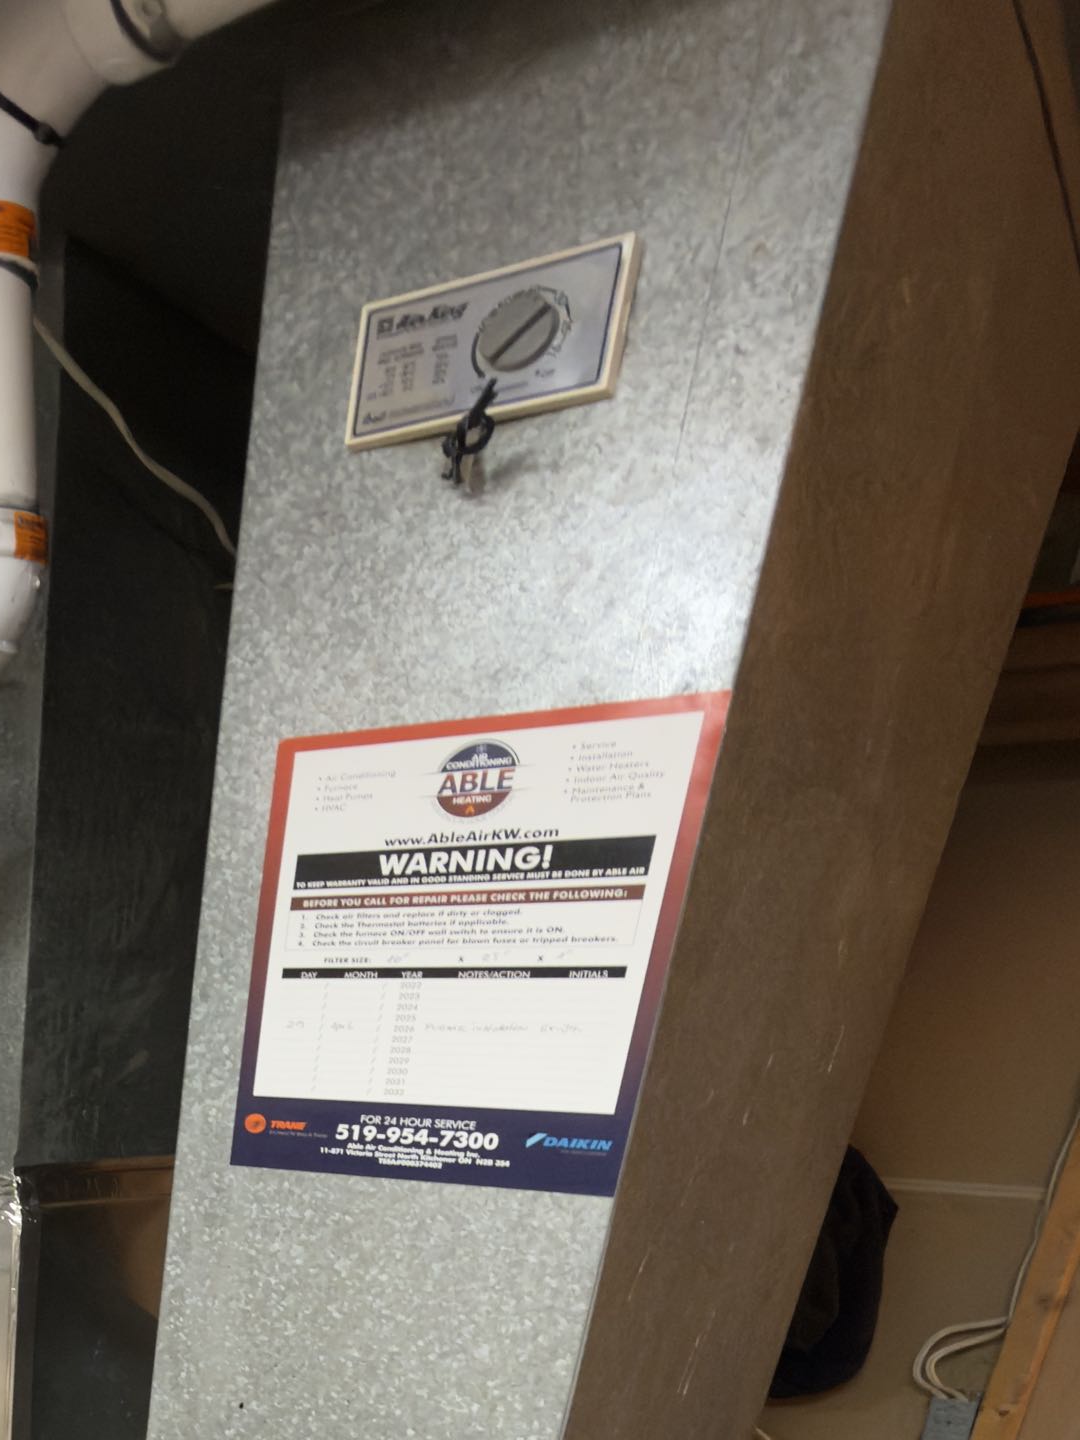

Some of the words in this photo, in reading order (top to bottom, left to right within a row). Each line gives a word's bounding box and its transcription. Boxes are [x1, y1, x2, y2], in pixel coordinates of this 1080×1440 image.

[437, 767, 516, 795] ABLE
[452, 794, 492, 805] HEATING
[384, 828, 560, 847] www.AbleAirKW.com
[378, 844, 554, 876] WARNING!
[296, 881, 306, 889] TO
[326, 879, 366, 888] WARRANTY
[367, 878, 390, 886] VALID
[391, 877, 409, 885] AND
[410, 876, 419, 884] IN
[421, 875, 447, 883] GOOD
[448, 873, 490, 883] STANDING
[492, 871, 525, 881] SERVICE
[526, 870, 551, 879] MUST
[552, 870, 562, 878] BE
[564, 869, 590, 878] DONE
[592, 868, 604, 877] BY
[605, 867, 627, 876] ABLE
[629, 866, 646, 875] AIR
[303, 898, 338, 908] BEFORE
[340, 897, 362, 907] YOU
[363, 896, 387, 906] CALL
[389, 895, 410, 905] FOR
[412, 894, 448, 904] REPAIR
[450, 892, 487, 903] PLEASE
[489, 890, 525, 902] CHECK
[529, 890, 550, 900] THE
[356, 912, 381, 920] filters
[402, 910, 435, 920] replace
[341, 921, 355, 929] the
[357, 919, 405, 928] Thermostat
[407, 918, 447, 927] batteries
[356, 929, 388, 937] furnace
[450, 927, 477, 936] switch
[312, 939, 336, 947] Check
[339, 939, 352, 947] the
[382, 938, 416, 946] breaker
[418, 937, 445, 947] panel
[462, 936, 490, 945] blown
[493, 936, 517, 944] fuses
[532, 935, 569, 945] tripped
[300, 971, 318, 979] DAY
[343, 971, 378, 979] MONTH
[401, 970, 424, 979] YEAR
[457, 970, 531, 979] NOTES/ACTION
[568, 969, 609, 978] INITIALS
[360, 1114, 382, 1125] FOR
[384, 1116, 397, 1125] 24
[399, 1116, 432, 1128] HOUR
[434, 1118, 477, 1130] SERVICE
[335, 1123, 499, 1151] 519-954-7300
[542, 1136, 613, 1151] DAIKIN
